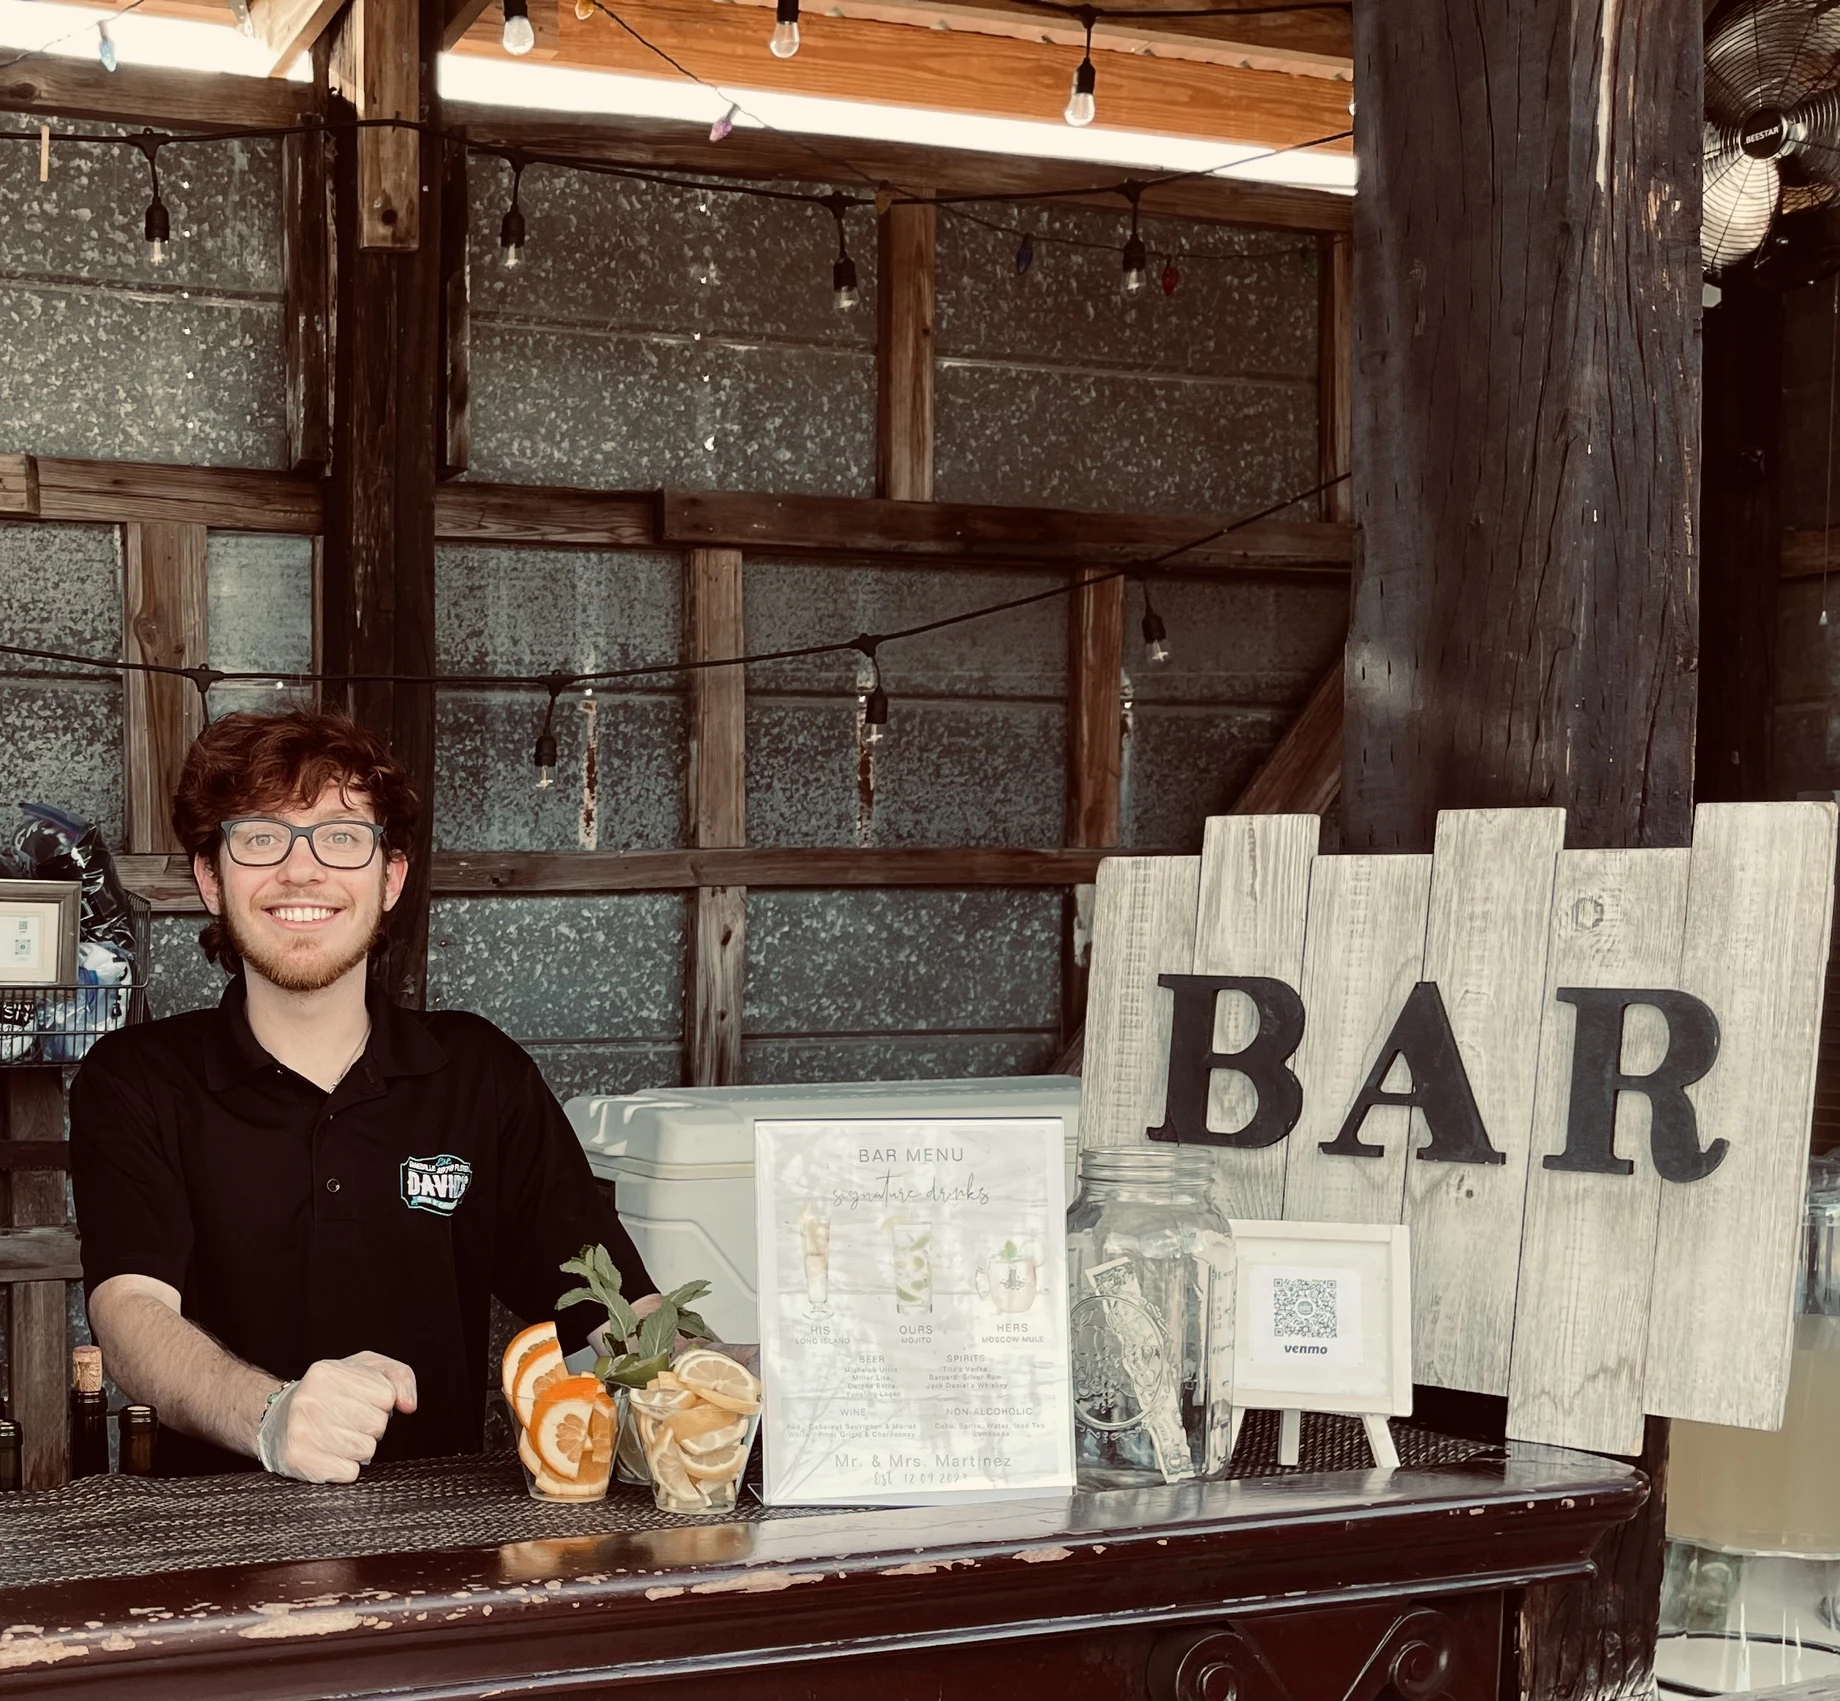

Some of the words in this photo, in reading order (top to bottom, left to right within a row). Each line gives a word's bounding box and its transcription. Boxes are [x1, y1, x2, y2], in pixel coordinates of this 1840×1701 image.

[1745, 126, 1779, 144] BEESTAR
[1146, 973, 1730, 1184] BAR
[859, 1149, 897, 1163] BAR
[907, 1148, 963, 1162] MENU
[832, 1169, 920, 1210] signature
[926, 1173, 990, 1205] drinks
[810, 1326, 830, 1335] HIS
[899, 1325, 933, 1335] OURS
[997, 1323, 1028, 1332] HERS
[1284, 1345, 1328, 1355] venmo
[859, 1355, 885, 1363] BEER
[947, 1354, 986, 1363] SPIRITS
[977, 1382, 1008, 1390] Whiskey
[840, 1408, 867, 1416] WINE
[835, 1454, 863, 1468] Mr.
[872, 1454, 881, 1468] &
[889, 1454, 927, 1468] Mrs.
[935, 1454, 1012, 1468] Martinez
